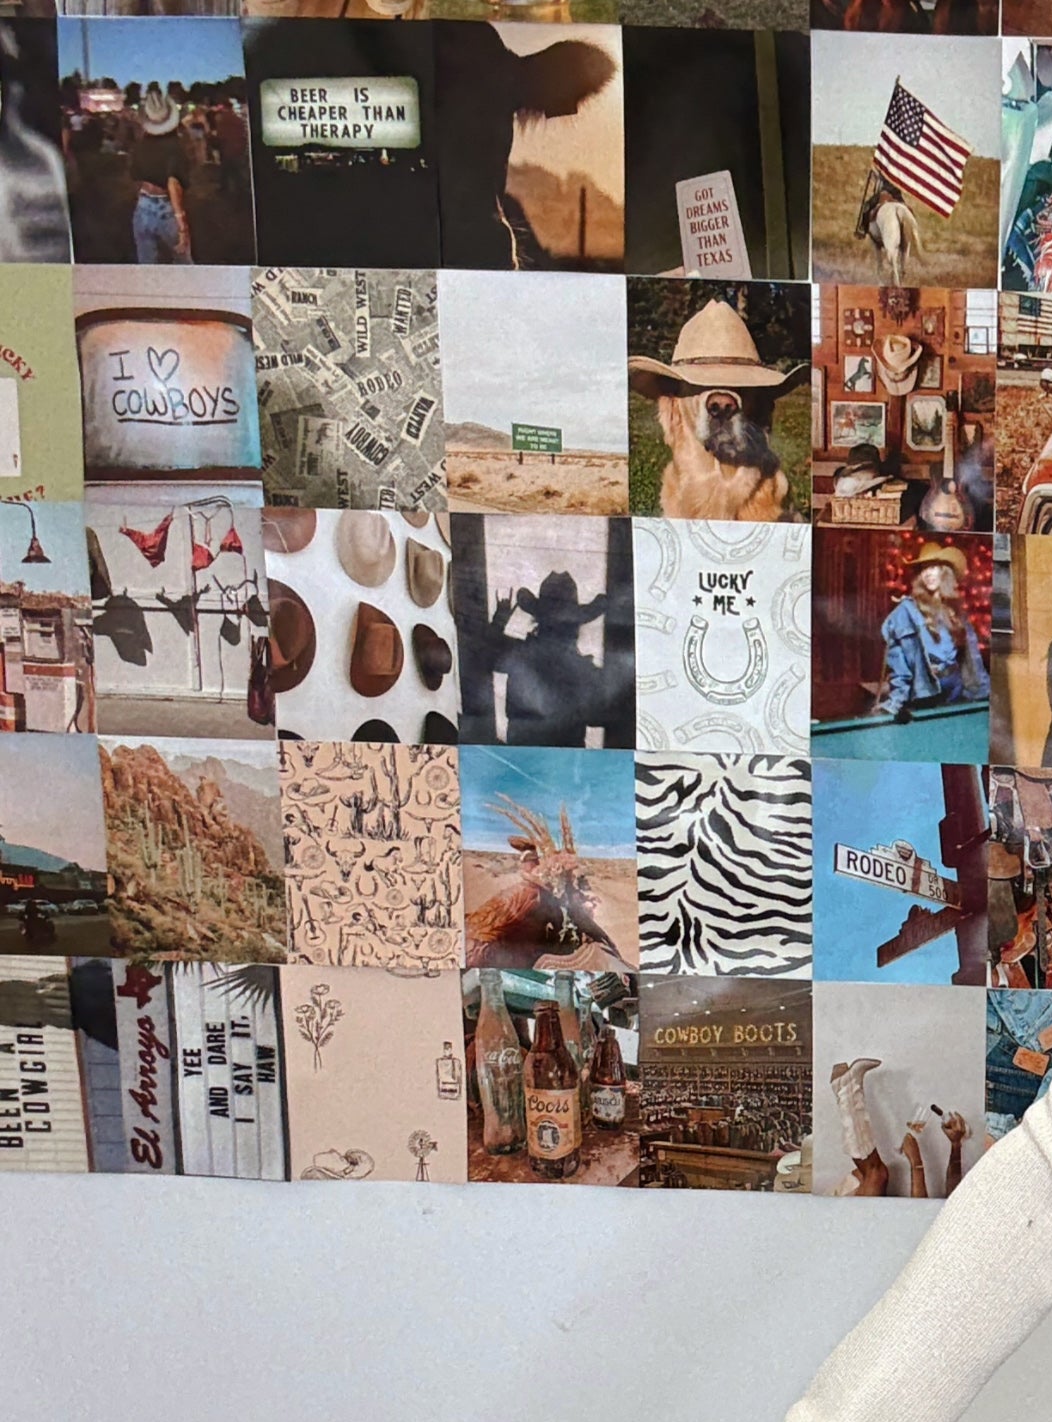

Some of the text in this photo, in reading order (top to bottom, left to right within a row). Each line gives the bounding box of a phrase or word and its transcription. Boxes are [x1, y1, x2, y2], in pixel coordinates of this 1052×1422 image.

[290, 87, 369, 103] BEER IS
[278, 105, 406, 121] CHEAPER THAN
[301, 123, 374, 139] THERAPY
[694, 187, 714, 202] GOT
[686, 199, 729, 219] DREAMS
[690, 215, 730, 235] BIGGER
[697, 233, 727, 250] THAN
[696, 248, 733, 267] TEXAS
[355, 270, 368, 353] WILD WEST
[109, 350, 135, 381] I
[112, 386, 240, 420] COWBOYS
[344, 422, 389, 466] COWBOY
[699, 570, 754, 594] LUCKY
[713, 595, 740, 616] ME
[847, 850, 907, 885] RODEO
[654, 1022, 797, 1044] COWBOY BOOTS
[183, 1048, 202, 1077] YEE
[206, 1022, 229, 1118] AND DARE
[257, 1045, 275, 1083] HAW
[232, 1063, 253, 1095] SAY
[129, 1015, 170, 1169] El Arroyo
[528, 1094, 569, 1112] Coors
[0, 1089, 23, 1148] BEEN
